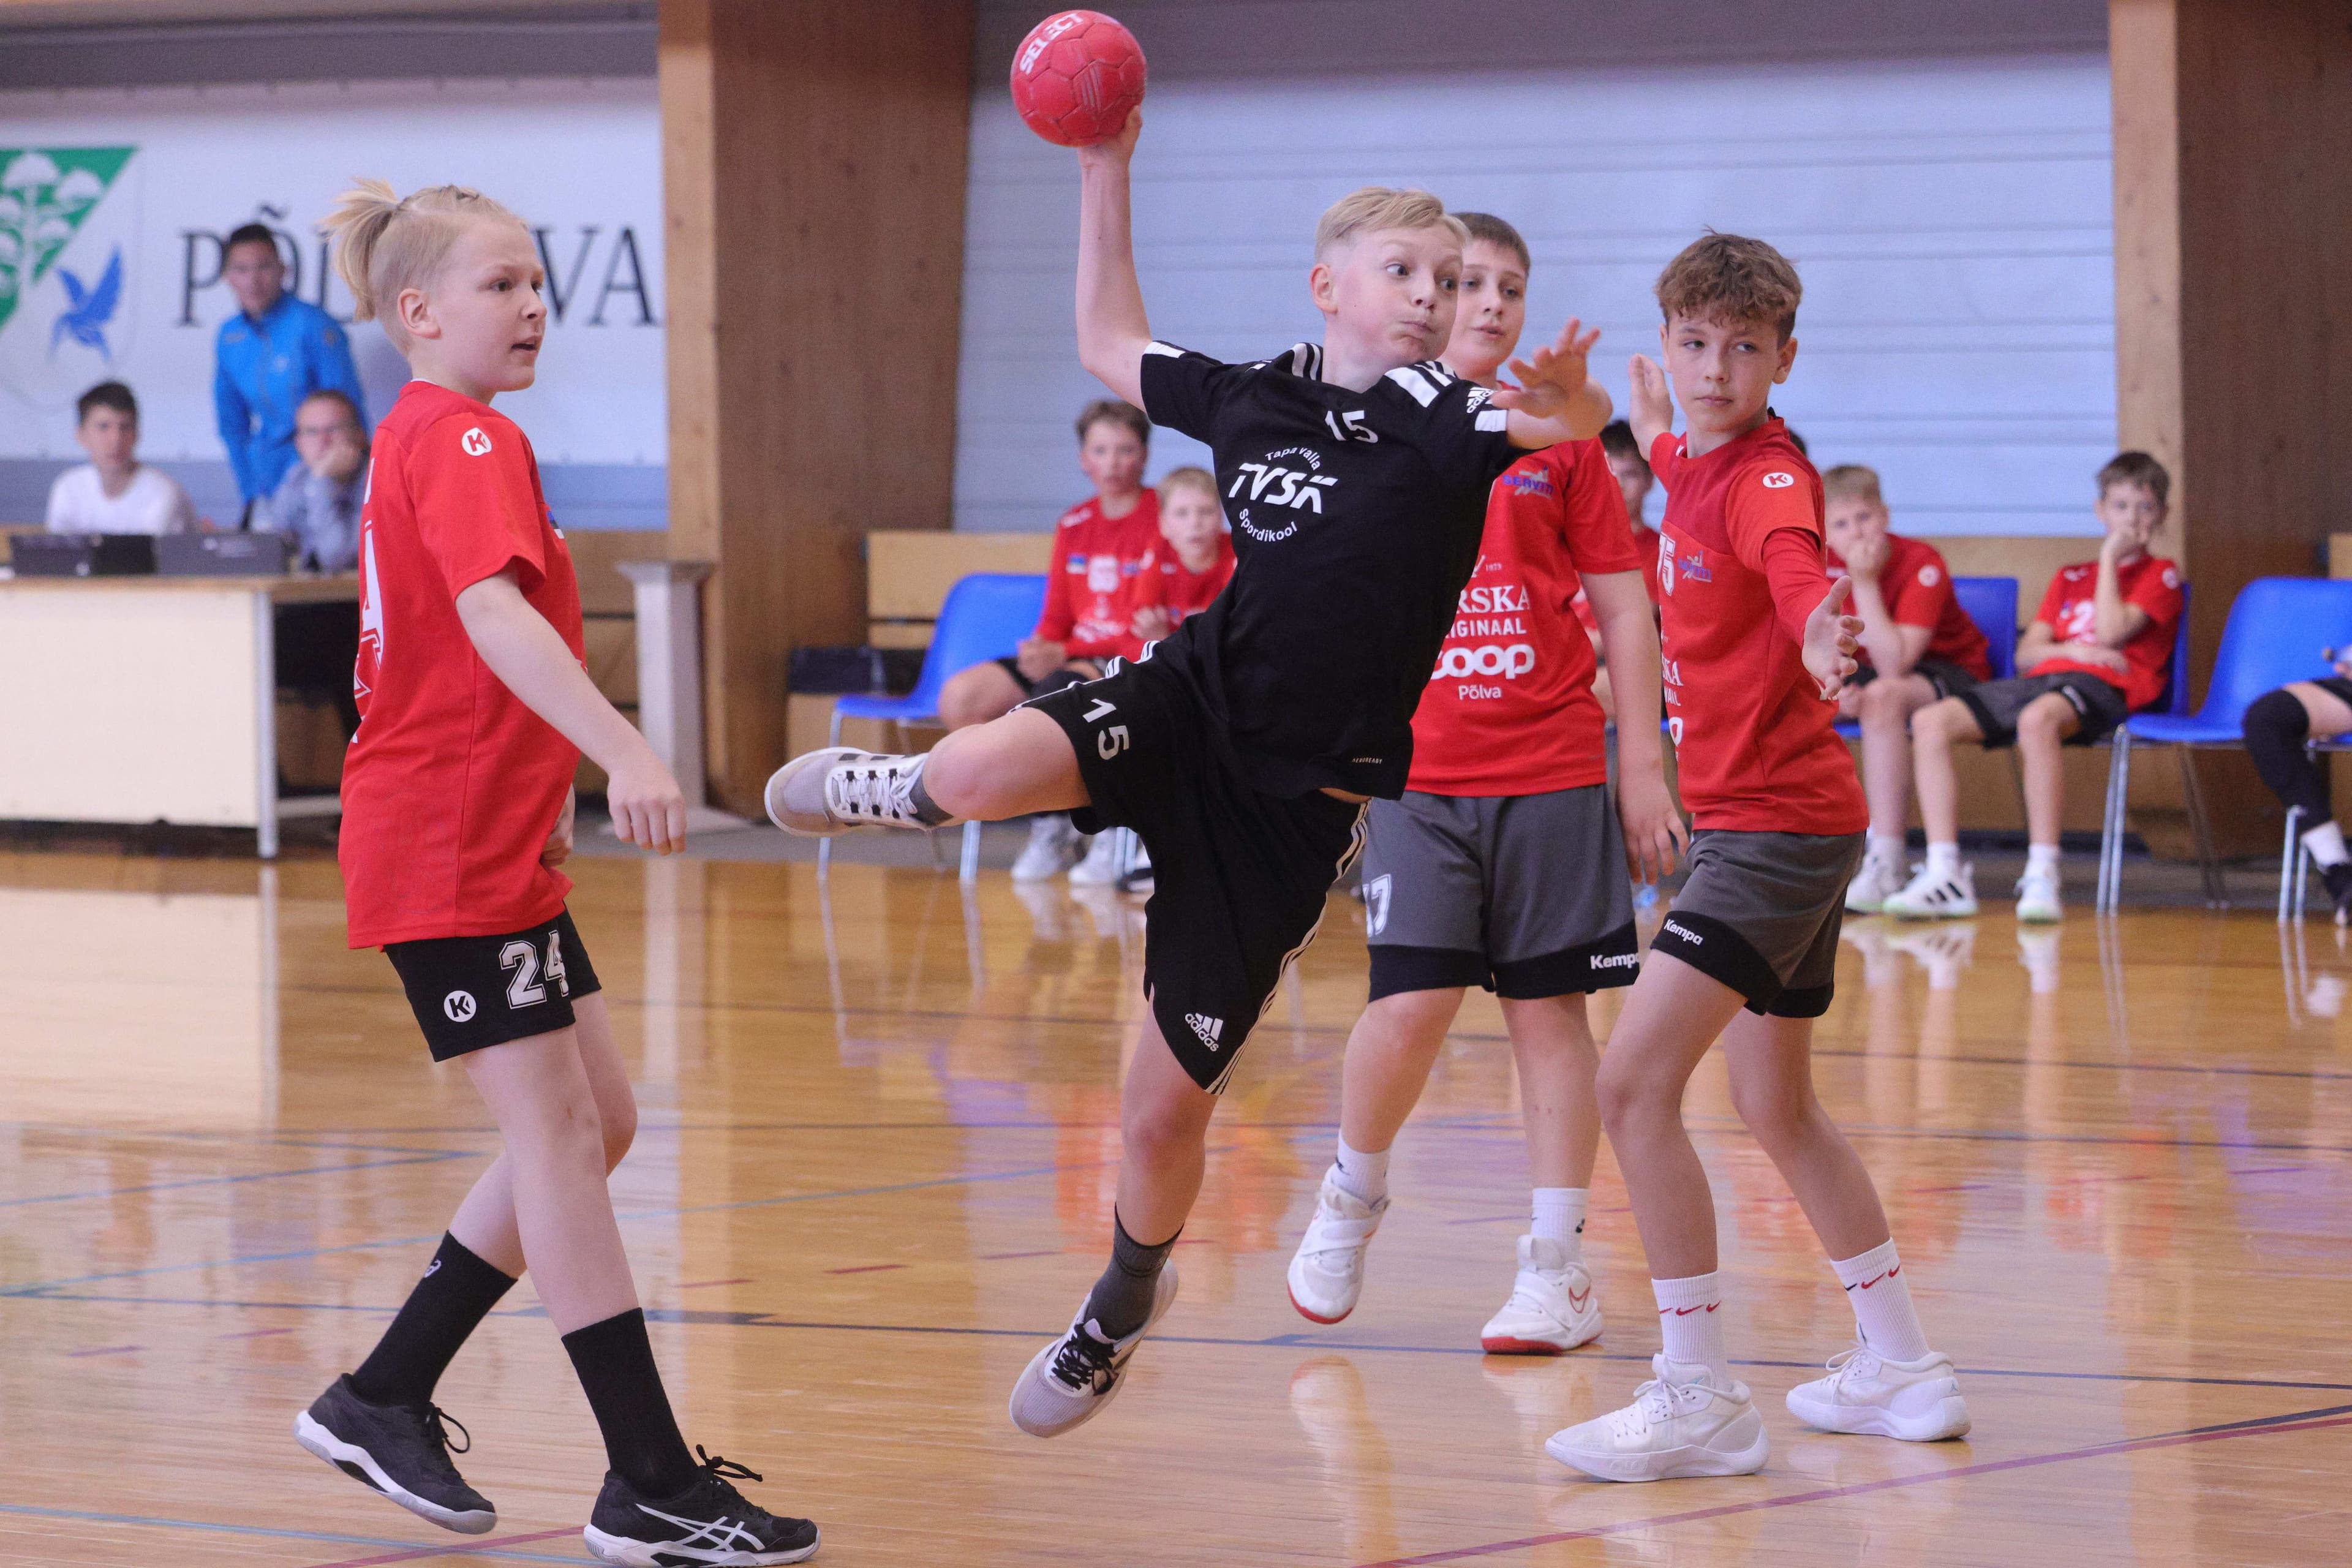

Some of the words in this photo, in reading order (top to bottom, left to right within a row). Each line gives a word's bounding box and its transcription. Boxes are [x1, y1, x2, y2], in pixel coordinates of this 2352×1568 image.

[1019, 13, 1084, 75] SELECT
[1325, 410, 1378, 443] 15
[1265, 447, 1298, 461] Tapa
[1298, 447, 1321, 470] valla
[1239, 508, 1298, 542] Spordikool
[1456, 584, 1529, 614] RSKA
[1446, 617, 1527, 639] IGINAAL
[1458, 684, 1502, 700] Põlva
[1082, 698, 1129, 760] 15
[1664, 919, 1703, 946] Kempa
[499, 930, 569, 1009] 24
[1185, 1013, 1219, 1052] adidas
